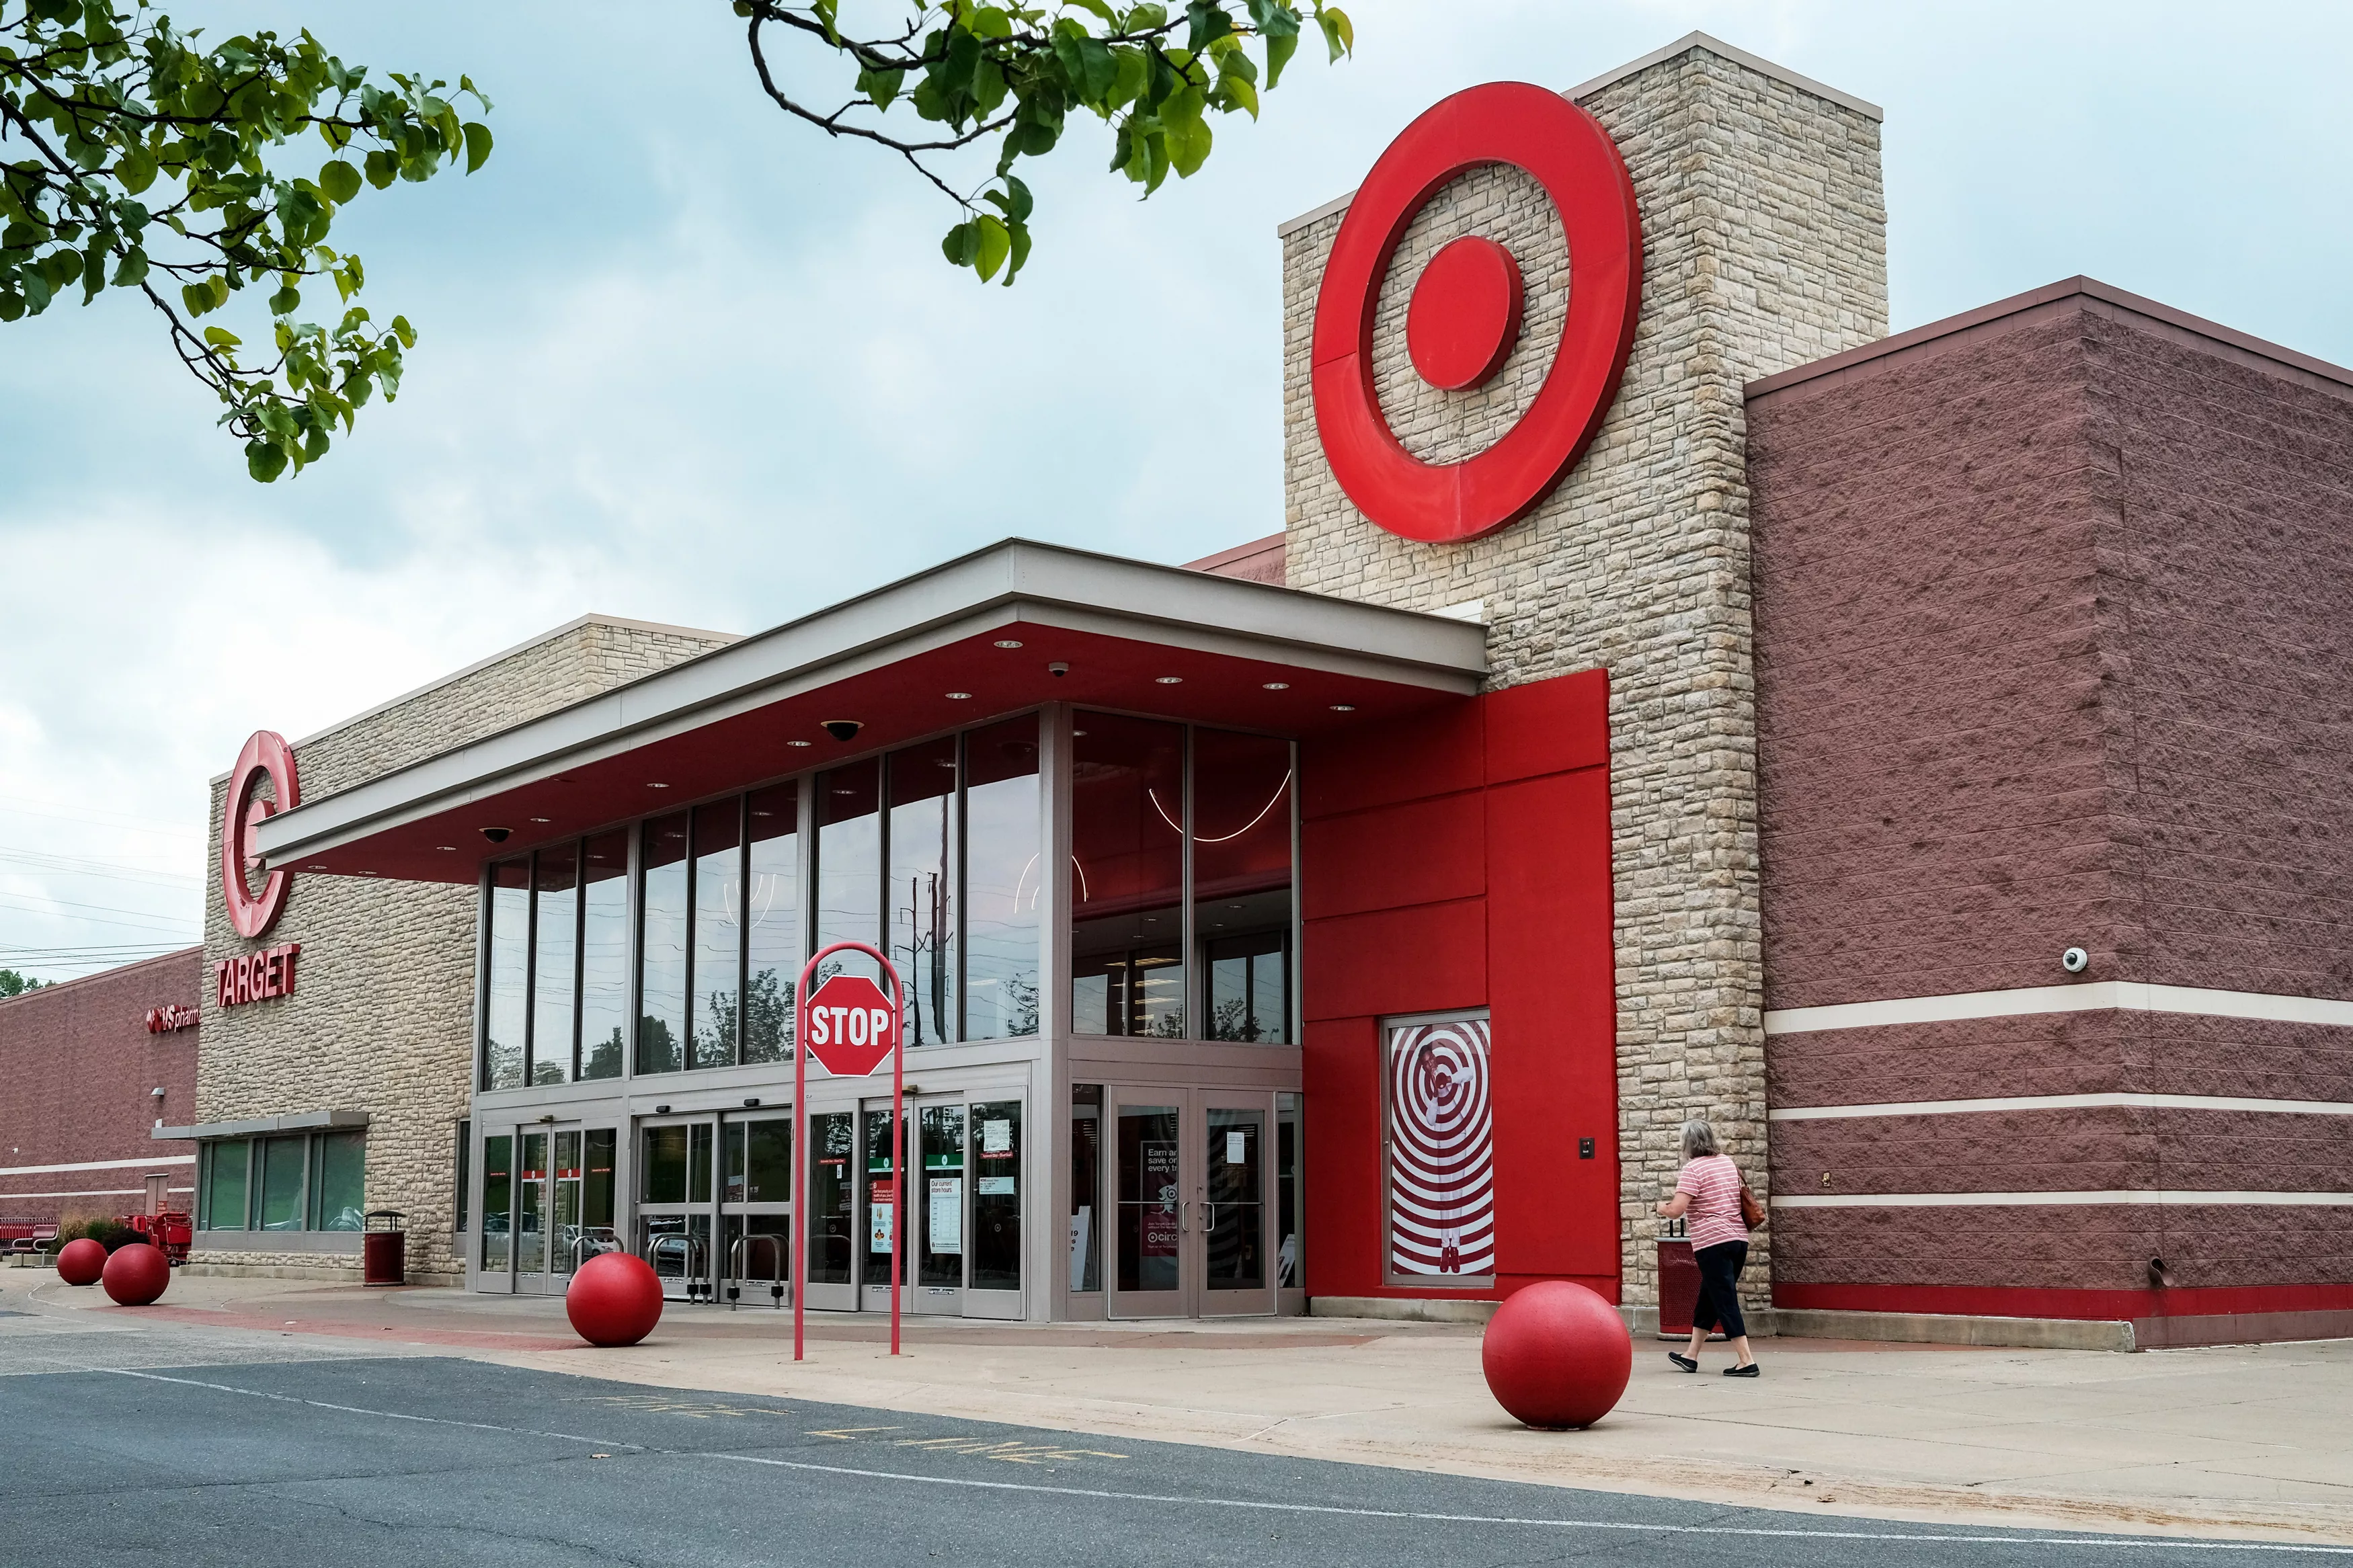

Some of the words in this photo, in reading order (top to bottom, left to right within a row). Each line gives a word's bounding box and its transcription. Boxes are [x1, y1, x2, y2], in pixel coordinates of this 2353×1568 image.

[214, 944, 300, 1007] TARGET
[811, 1005, 889, 1046] STOP
[1148, 1164, 1170, 1173] every
[1158, 1231, 1177, 1241] circ
